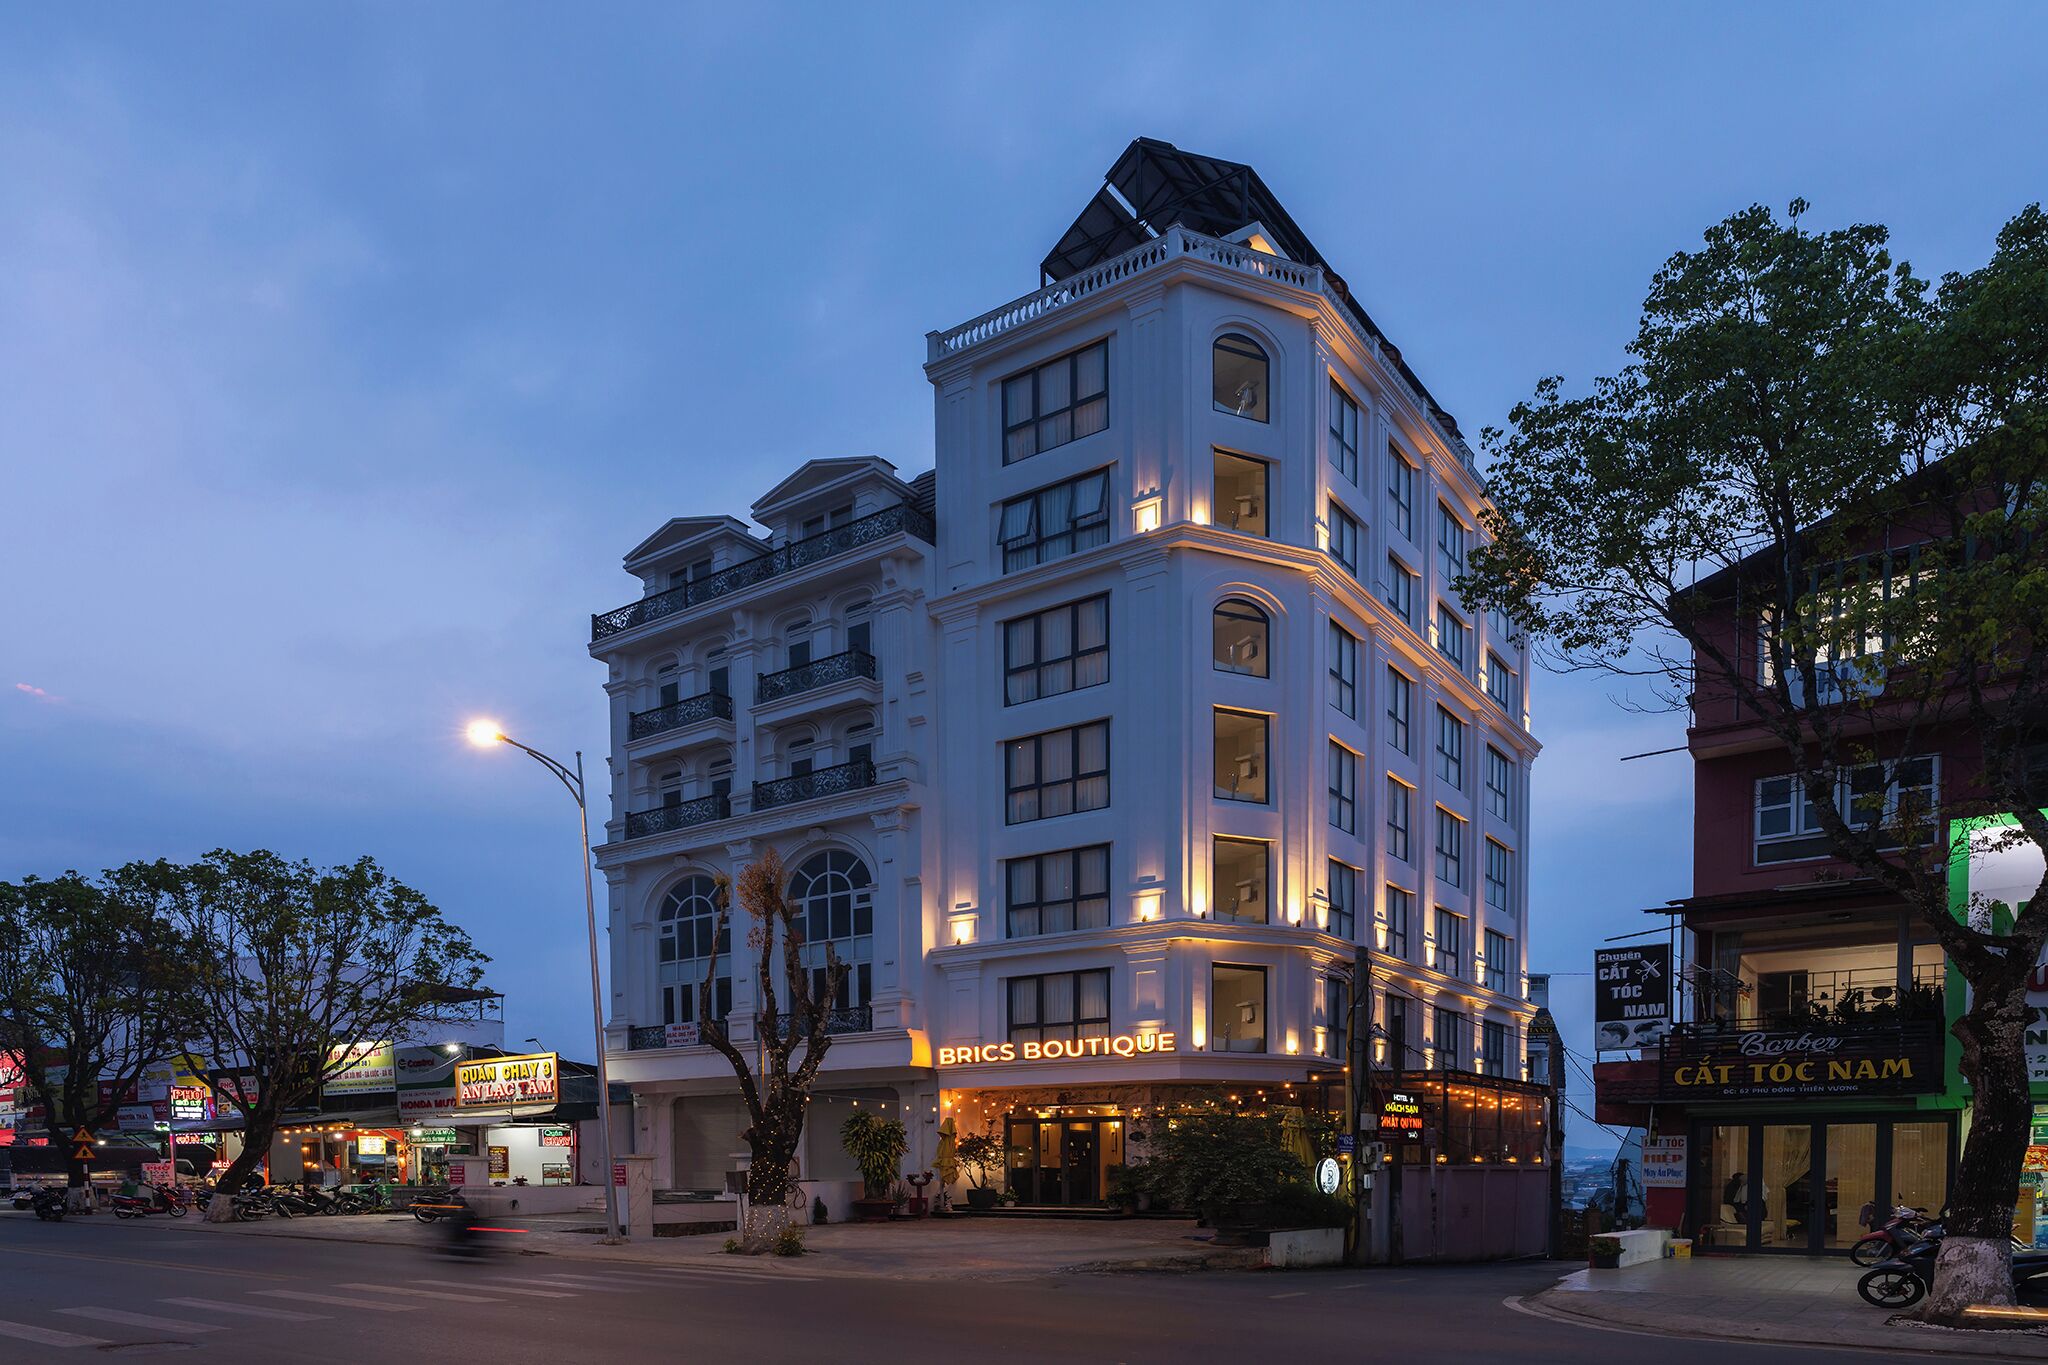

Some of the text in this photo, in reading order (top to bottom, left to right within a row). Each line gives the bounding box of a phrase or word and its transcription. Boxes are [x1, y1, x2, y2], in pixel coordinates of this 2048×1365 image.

[1598, 951, 1641, 963] Chuyên
[1599, 962, 1630, 981] CẮT
[1610, 983, 1643, 999] TÓC
[1624, 1003, 1665, 1018] NAM
[938, 1031, 1176, 1066] BRICS BOUTIQUE
[1738, 1031, 1844, 1056] Barber
[461, 1061, 552, 1084] QUÁN CHAY 3
[1674, 1055, 1914, 1086] CẮT TÓC NAM
[461, 1085, 482, 1100] AN
[485, 1082, 516, 1100] LẠC
[1393, 1093, 1408, 1102] HOTEL
[1739, 1087, 1749, 1095] 62
[401, 1099, 432, 1109] HONDA
[1405, 1104, 1419, 1114] SẠN
[544, 1129, 563, 1137] Quán
[1343, 1135, 1354, 1146] 62
